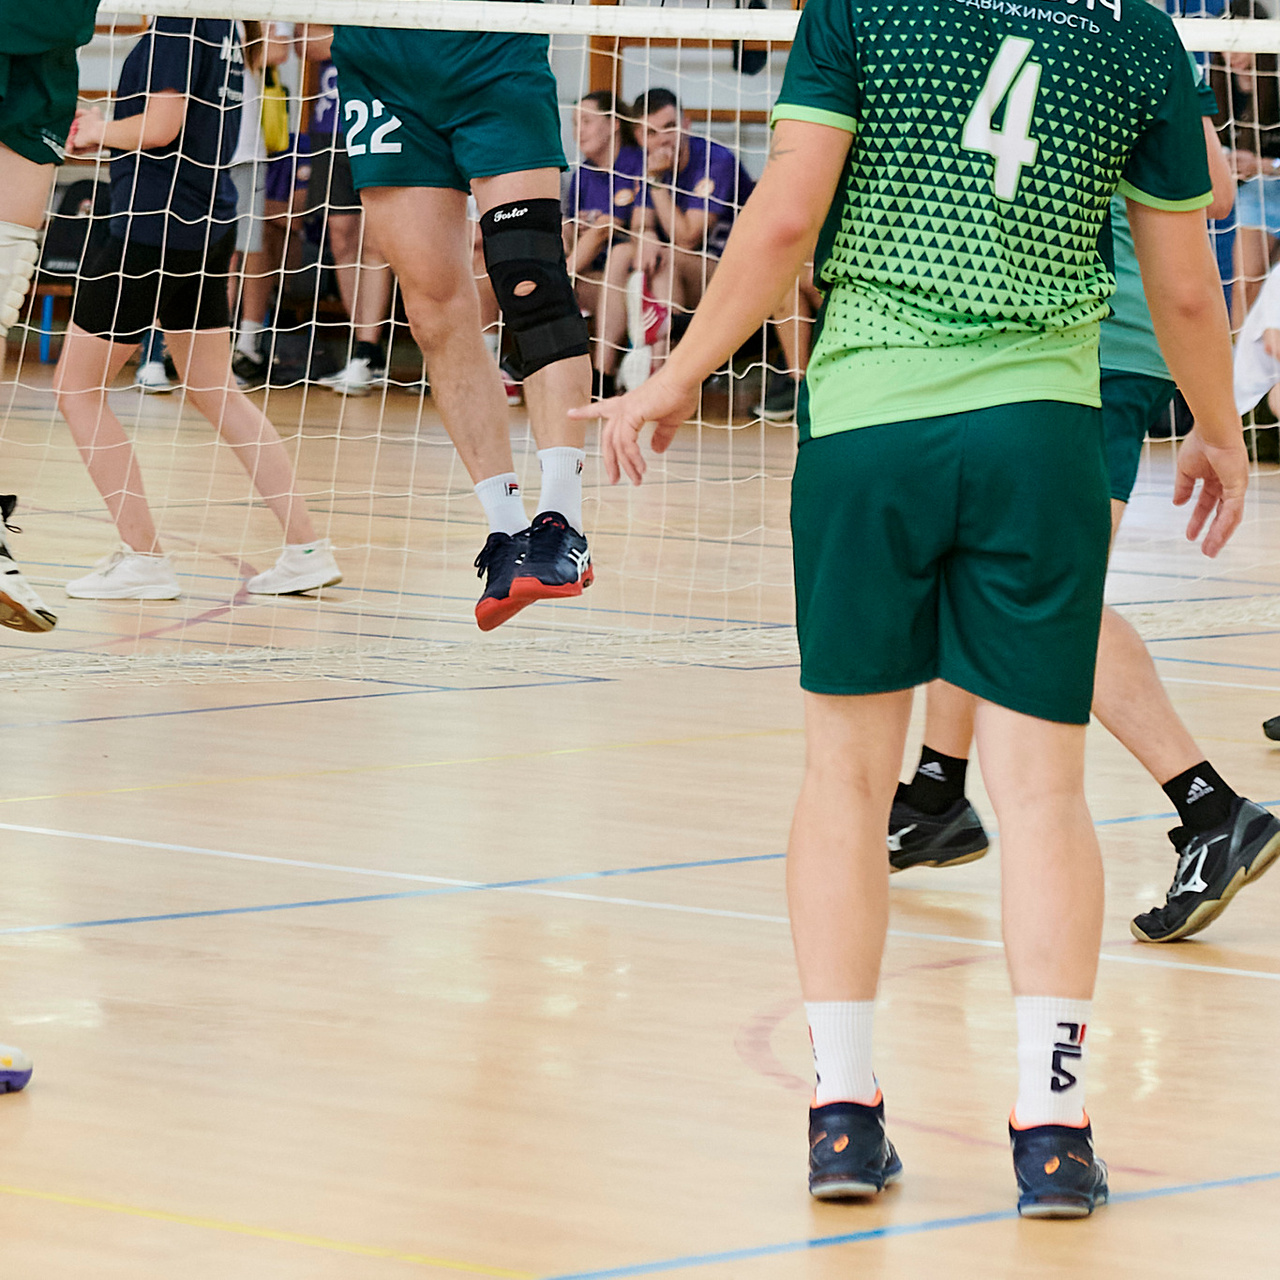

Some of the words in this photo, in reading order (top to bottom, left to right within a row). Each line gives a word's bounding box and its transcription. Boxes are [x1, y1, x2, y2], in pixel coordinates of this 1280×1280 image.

[344, 98, 403, 157] 22
[961, 35, 1042, 202] 4
[1050, 1021, 1086, 1093] FILA
